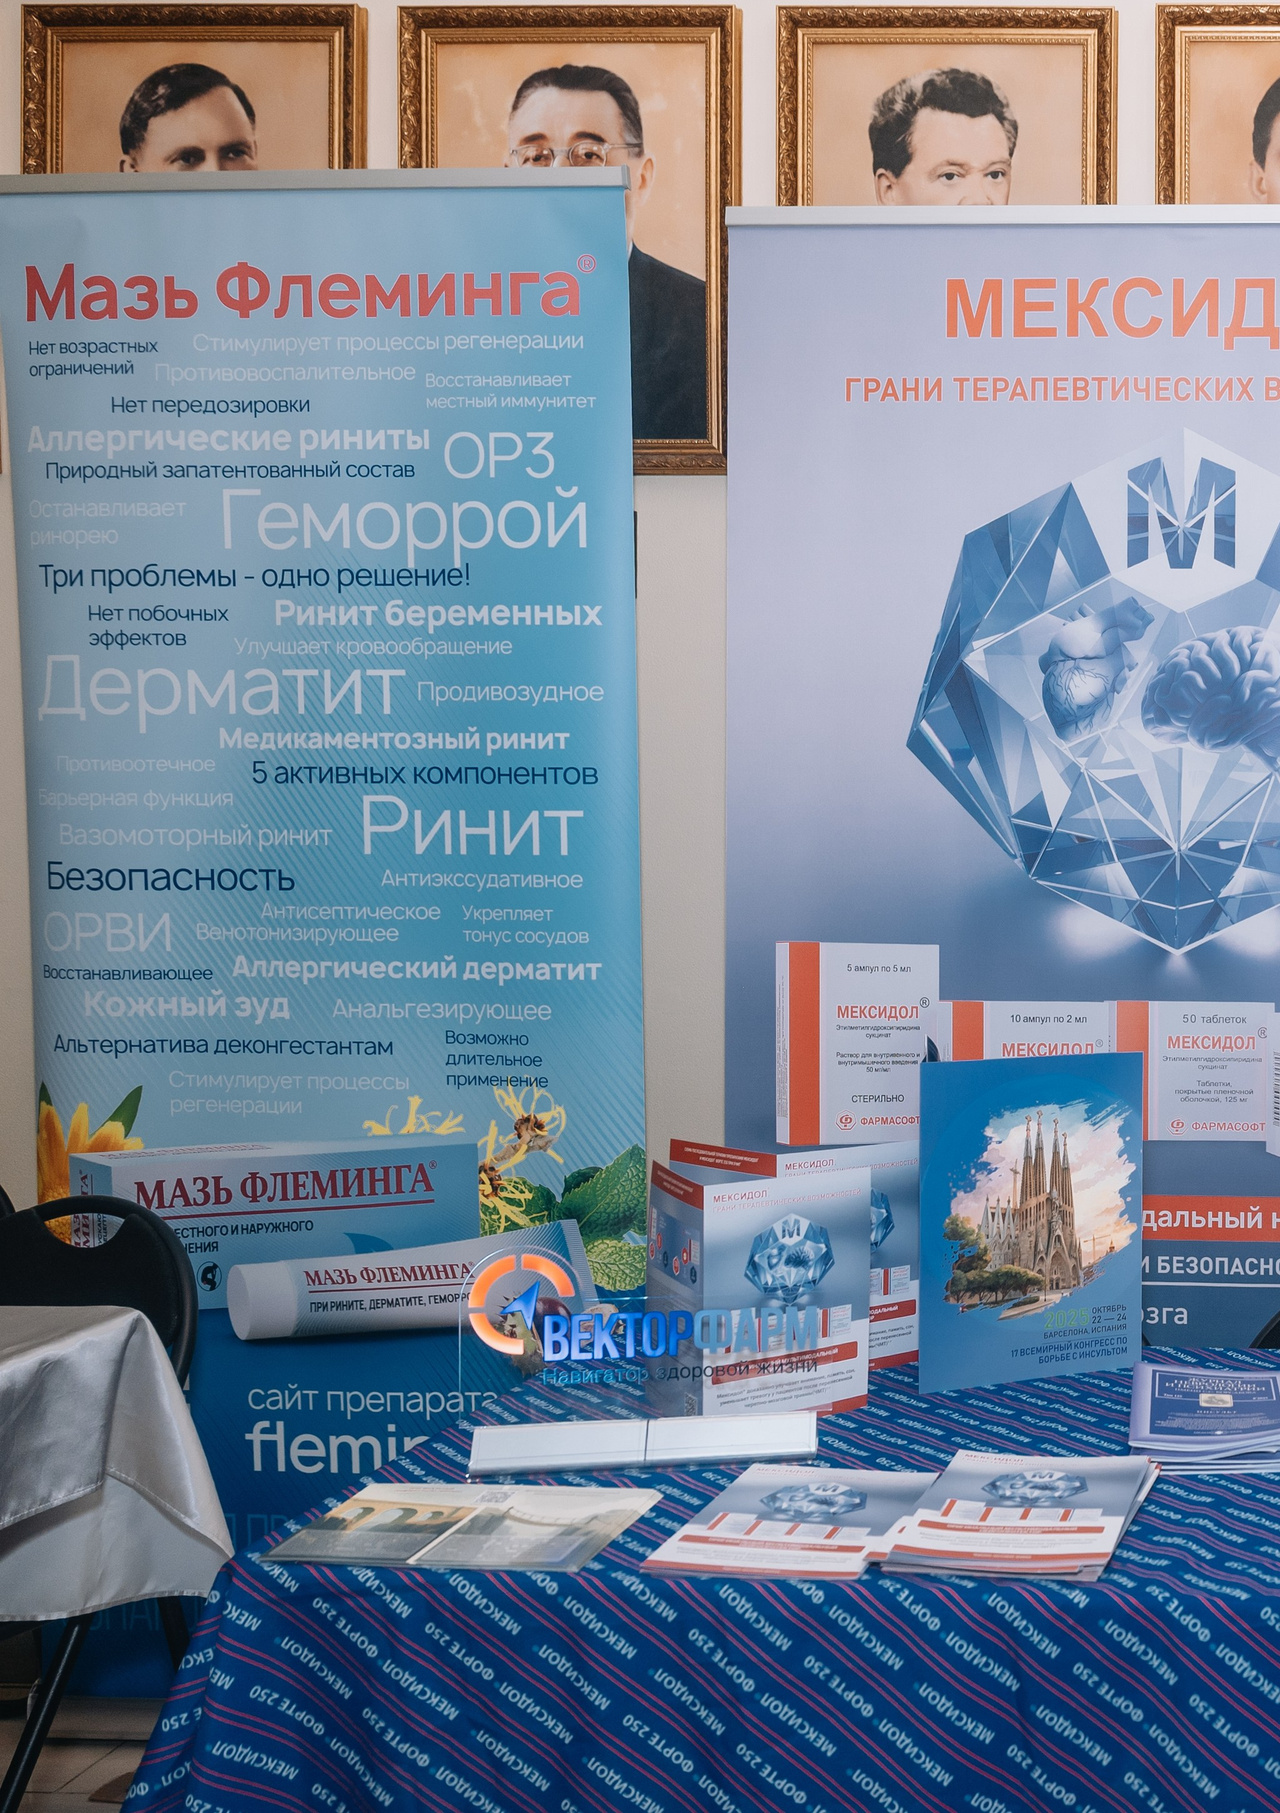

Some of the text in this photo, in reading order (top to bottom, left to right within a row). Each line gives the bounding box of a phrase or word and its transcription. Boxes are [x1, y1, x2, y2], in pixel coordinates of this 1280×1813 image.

[25, 263, 199, 321] Мазь
[28, 340, 159, 356] Нет возрастных
[29, 360, 134, 379] ограничений
[425, 373, 571, 388] Восстанавливает
[845, 376, 942, 402] ГРАНИ
[953, 376, 1253, 402] ТЕРАПЕВТИЧЕСКИХ
[111, 397, 310, 417] Нет передозировки
[426, 393, 597, 410] местный иммунитет
[28, 426, 430, 458] Аллергические риниты
[46, 460, 415, 484] Природный запатентованный состав
[222, 486, 587, 568] Геморрой
[40, 562, 470, 593] Три проблемы одно решение!
[88, 604, 229, 623] Нет побочных
[276, 599, 602, 631] Ринит беременных
[89, 628, 186, 649] эффектов
[38, 654, 405, 733] Дерматит
[220, 729, 570, 756] Медикаментозный ринит
[252, 761, 598, 786] 5 активных компонентов
[363, 795, 584, 856] Ринит
[47, 860, 295, 891] Безопасность
[381, 869, 583, 890] Антиэкссудативное
[462, 905, 553, 923] Укрепляет
[463, 929, 589, 947] тонус сосудов
[233, 954, 602, 984] Аллергический дерматит
[847, 963, 852, 973] 5
[854, 965, 880, 974] ампул
[893, 964, 898, 973] 5
[85, 989, 290, 1024] Кожный зуд
[1010, 1014, 1021, 1024] 10
[1022, 1015, 1050, 1025] ампул
[1053, 1016, 1065, 1024] по
[1067, 1014, 1072, 1023] 2
[1183, 1014, 1247, 1024] 50 таблеток
[54, 1033, 393, 1057] Альтернатива деконгестантам
[445, 1031, 529, 1047] Возможно
[446, 1051, 542, 1068] длительное
[446, 1072, 548, 1088] применение
[851, 1094, 904, 1104] СТЕРИЛЬНО
[860, 1115, 920, 1127] ФАРМАСОФТ
[1192, 1122, 1265, 1132] ФАРМАСОФТ
[134, 1175, 233, 1210] МАЗЬ
[241, 1220, 313, 1235] НАРУЖНОГО
[304, 1267, 357, 1286] МАЗЬ
[309, 1295, 425, 1313] ПРИ РИНИТЕ, ДЕРМАТИТЕ,
[1044, 1304, 1126, 1330] 2025 ОКТЯБРЬ
[543, 1305, 817, 1362] ВЕКТОРФАРМ
[1091, 1323, 1126, 1334] ИСПАНИЯ
[1020, 1339, 1115, 1357] ВСЕМИРНЫЙ КОНГРЕСС
[1039, 1348, 1127, 1364] БОРЬБЕ ИНСУЛЬТОМ
[543, 1361, 818, 1386] Навигатор здоровой жизни
[247, 1384, 318, 1411] сайт
[688, 1628, 837, 1757] МЕКСИДОЛ ФОРТЕ 250
